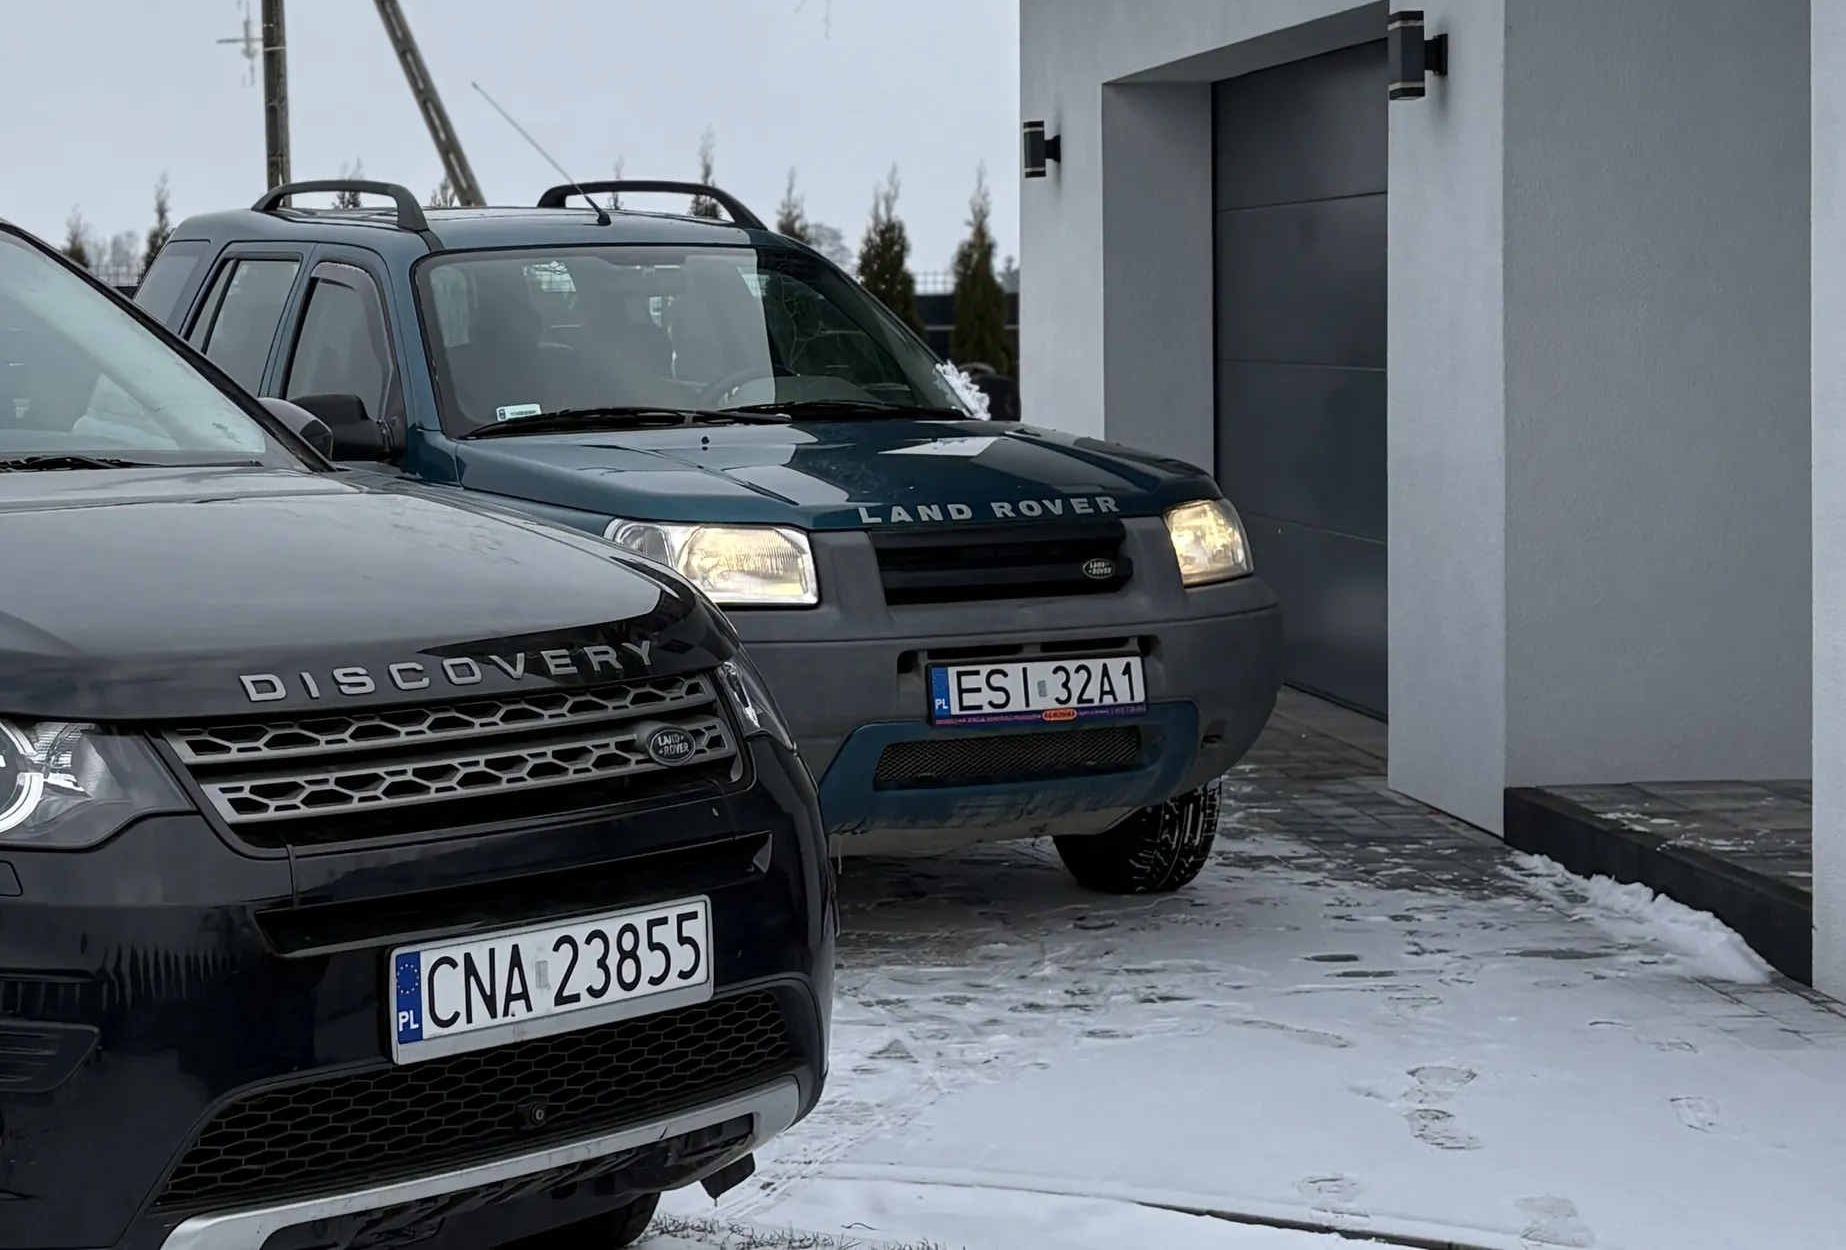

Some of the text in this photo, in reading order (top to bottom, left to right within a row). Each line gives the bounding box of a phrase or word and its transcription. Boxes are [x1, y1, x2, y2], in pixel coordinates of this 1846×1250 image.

[858, 496, 1120, 524] LAND ROVER
[239, 640, 653, 702] DISCOVERY
[956, 661, 1135, 712] ESI 32A1
[935, 698, 949, 710] PL
[658, 733, 680, 747] LAND
[663, 742, 690, 756] ROVER
[427, 910, 699, 1029] CNA 23855
[398, 1010, 419, 1033] PL
